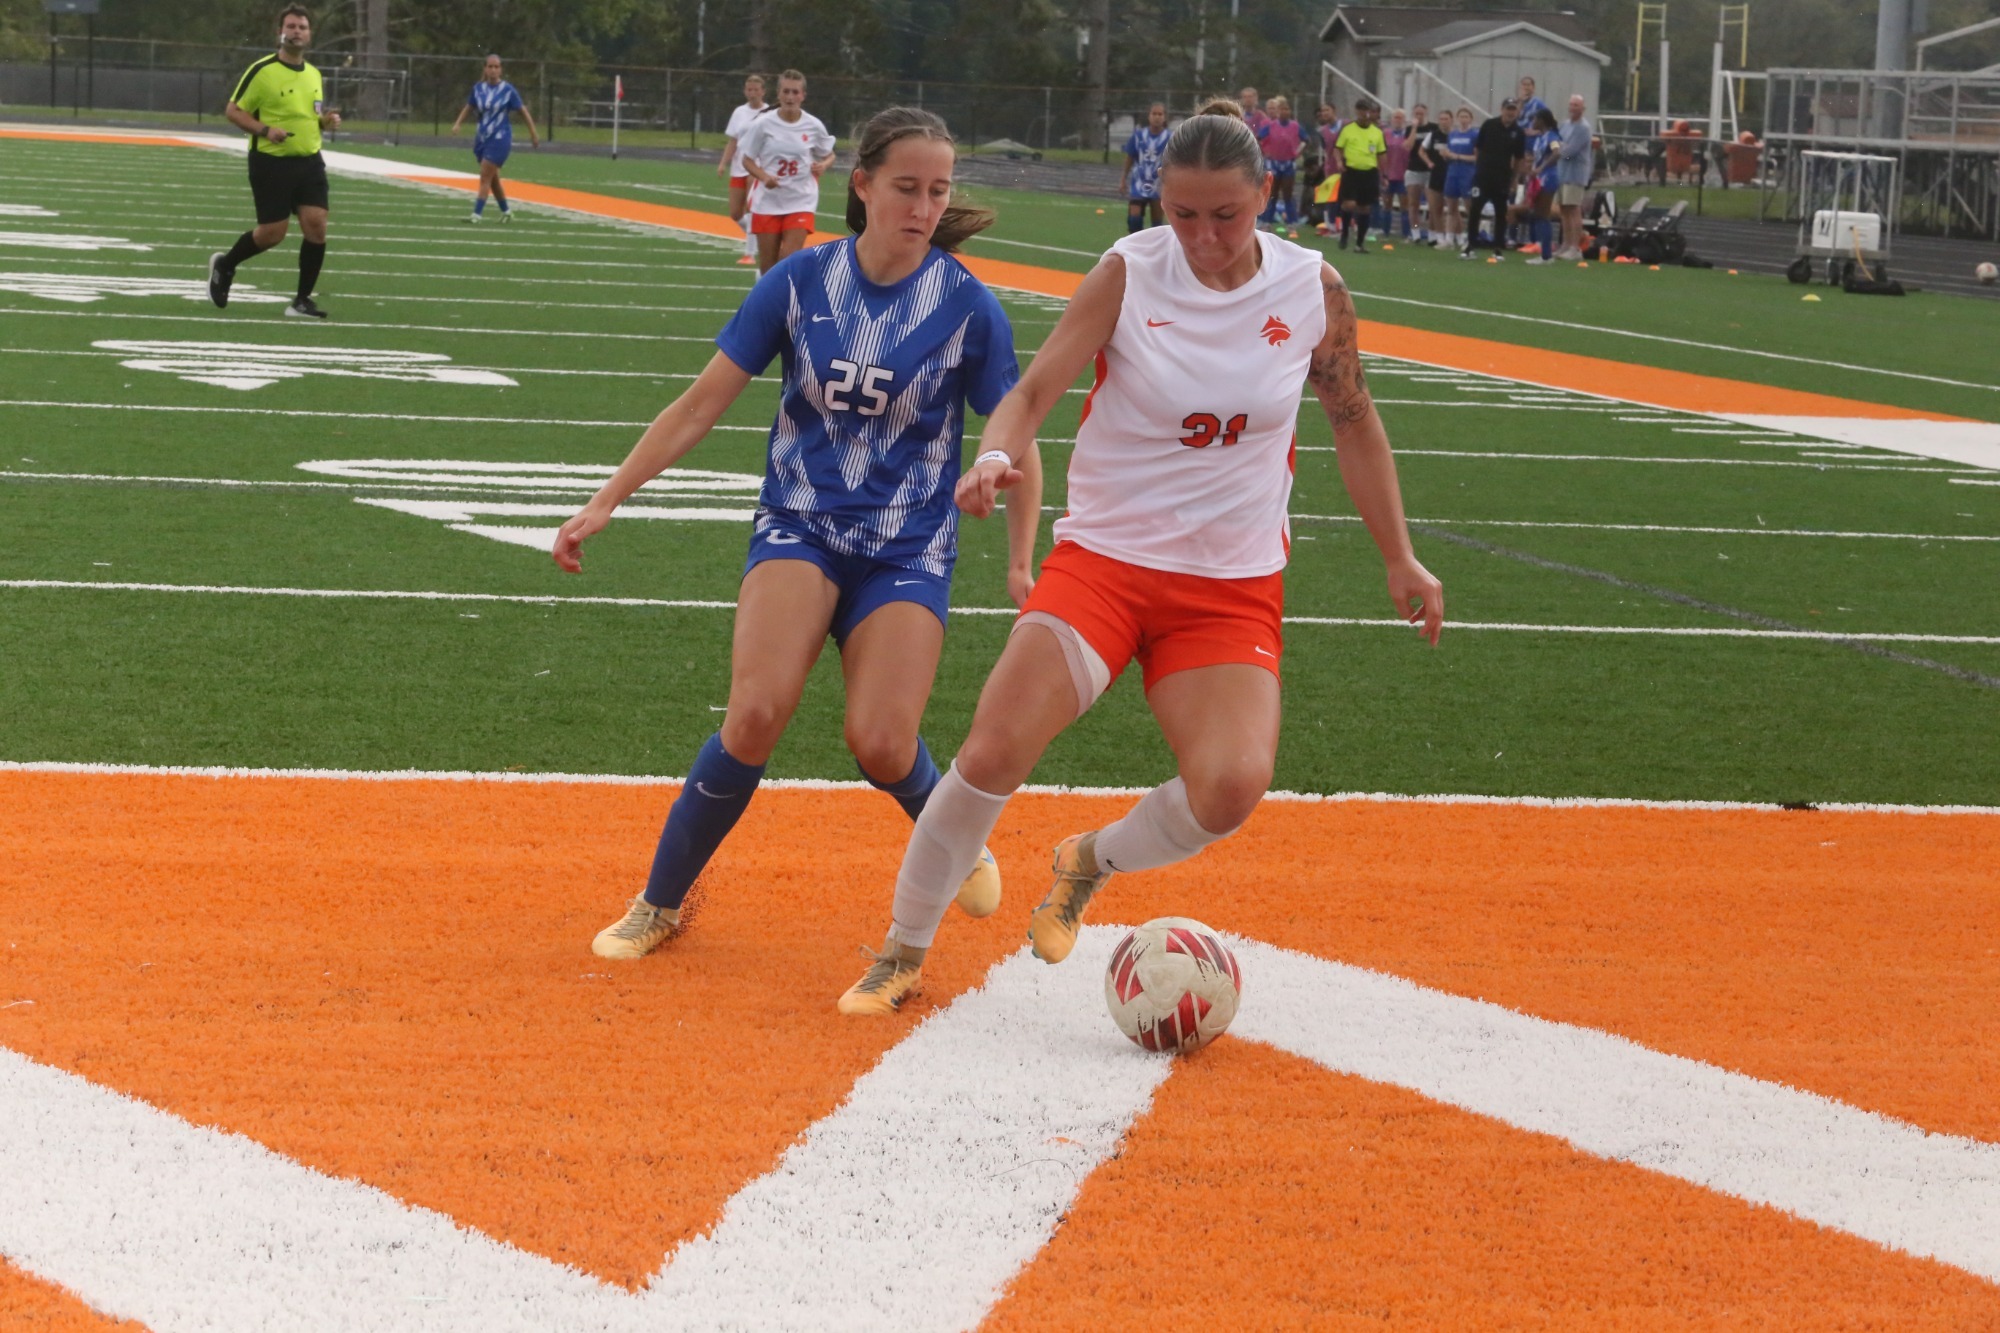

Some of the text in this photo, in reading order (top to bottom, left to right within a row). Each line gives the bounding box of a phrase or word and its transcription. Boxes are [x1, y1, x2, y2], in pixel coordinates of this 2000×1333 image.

[777, 159, 799, 177] 26
[824, 357, 896, 417] 25
[1179, 412, 1249, 449] 31
